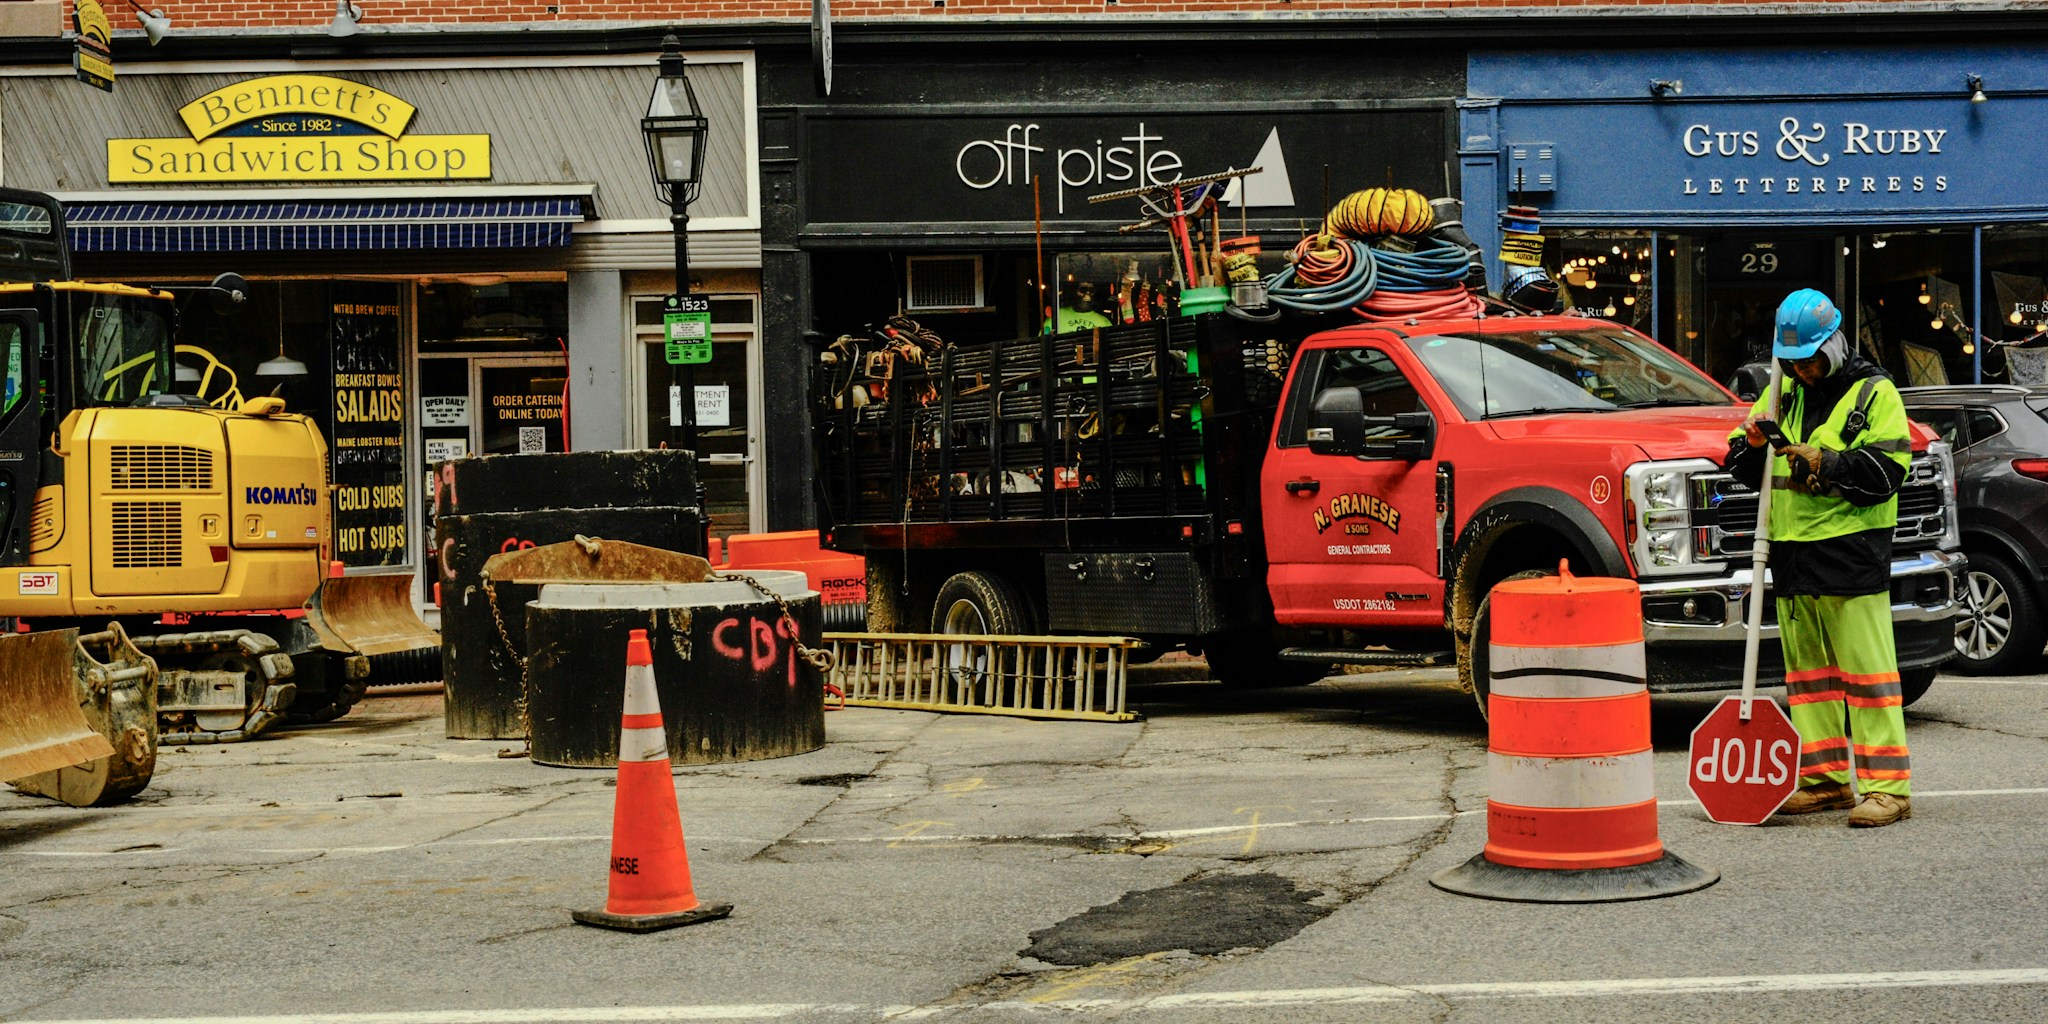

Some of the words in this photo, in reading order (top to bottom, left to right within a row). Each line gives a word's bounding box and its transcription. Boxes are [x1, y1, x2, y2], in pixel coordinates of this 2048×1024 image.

[200, 83, 391, 128] Bennett's
[262, 120, 297, 132] Since
[301, 119, 332, 131] 1982
[1776, 116, 1830, 166] &
[132, 141, 343, 175] Sandwich
[358, 140, 466, 178] Shop
[1058, 122, 1183, 214] piste
[1683, 175, 1947, 194] LETTERPRESS
[1741, 253, 1779, 273] 29
[333, 303, 354, 315] NITRO
[355, 304, 373, 315] BREW
[375, 305, 399, 316] COFFEE
[682, 300, 708, 311] 1523
[1587, 307, 1607, 317] RU
[335, 374, 375, 388] BREAKFAST
[377, 374, 401, 387] BOWLS
[493, 395, 523, 406] ORDER
[526, 394, 563, 405] CATERIN
[672, 390, 727, 399] ATMENT
[336, 389, 401, 423] SALADS
[425, 398, 443, 407] OPEN
[445, 398, 465, 406] DAILY
[698, 400, 722, 408] RENT
[500, 408, 532, 419] ONLINE
[337, 437, 356, 448] MAINE
[357, 437, 382, 448] LOBSTER
[384, 436, 402, 447] ROLLS
[246, 483, 317, 506] KOMATSU
[1595, 482, 1606, 498] 92
[339, 487, 370, 511] COLD
[373, 484, 404, 509] SUBS
[1313, 507, 1331, 533] N.
[1330, 493, 1400, 533] GRANESE
[1345, 524, 1350, 533] &
[1351, 523, 1369, 534] SONS
[339, 527, 366, 552] HOT
[370, 524, 405, 550] SUBS
[1328, 545, 1351, 555] GENERAL
[1352, 544, 1391, 554] CONTRACTORS
[22, 575, 54, 587] SBT
[1333, 599, 1361, 610] USDOT
[1363, 599, 1396, 610] 2862182
[1696, 738, 1792, 786] STOP
